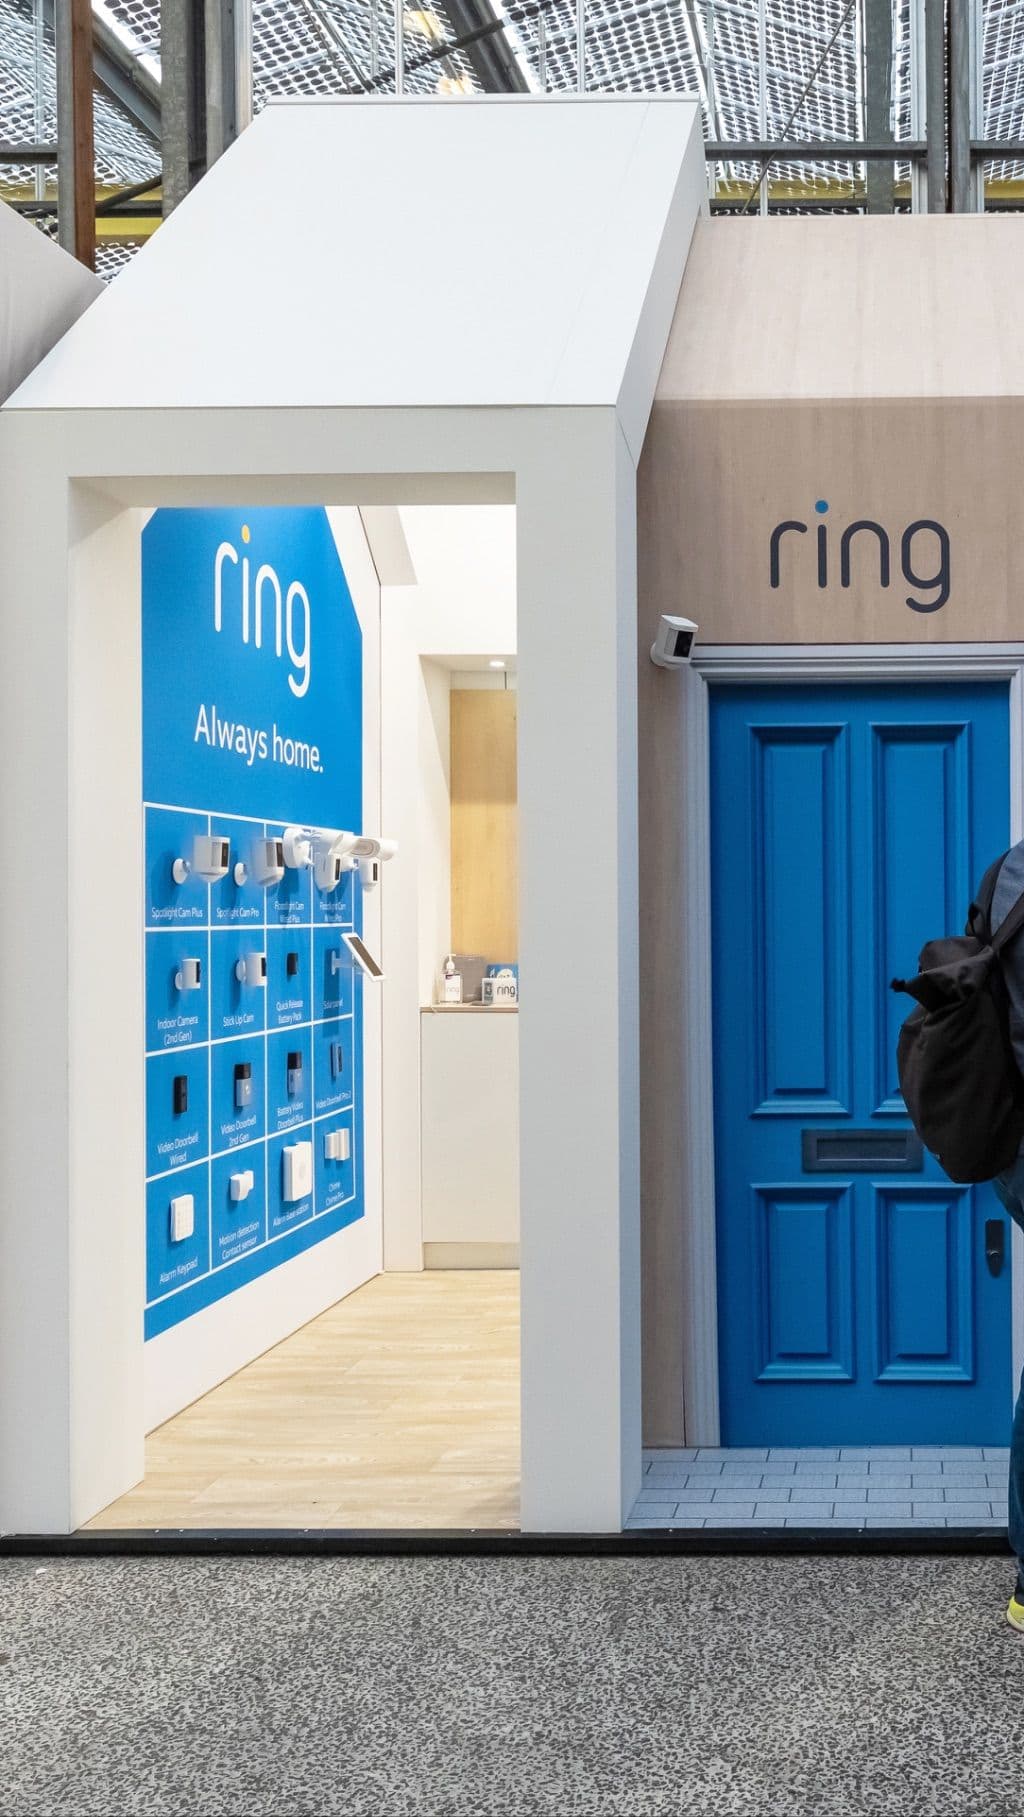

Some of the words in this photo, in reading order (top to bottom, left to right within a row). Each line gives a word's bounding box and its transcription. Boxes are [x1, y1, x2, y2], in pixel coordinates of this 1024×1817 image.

[769, 499, 951, 614] ring
[214, 524, 311, 698] ring
[194, 703, 267, 766] Always
[273, 723, 324, 774] home.
[192, 907, 203, 918] Plus
[497, 984, 516, 998] ring
[157, 1017, 177, 1030] Indoor
[177, 1015, 199, 1027] Camera
[157, 1141, 174, 1154] Video
[170, 1151, 187, 1166] Wired
[176, 1256, 198, 1275] Keypad
